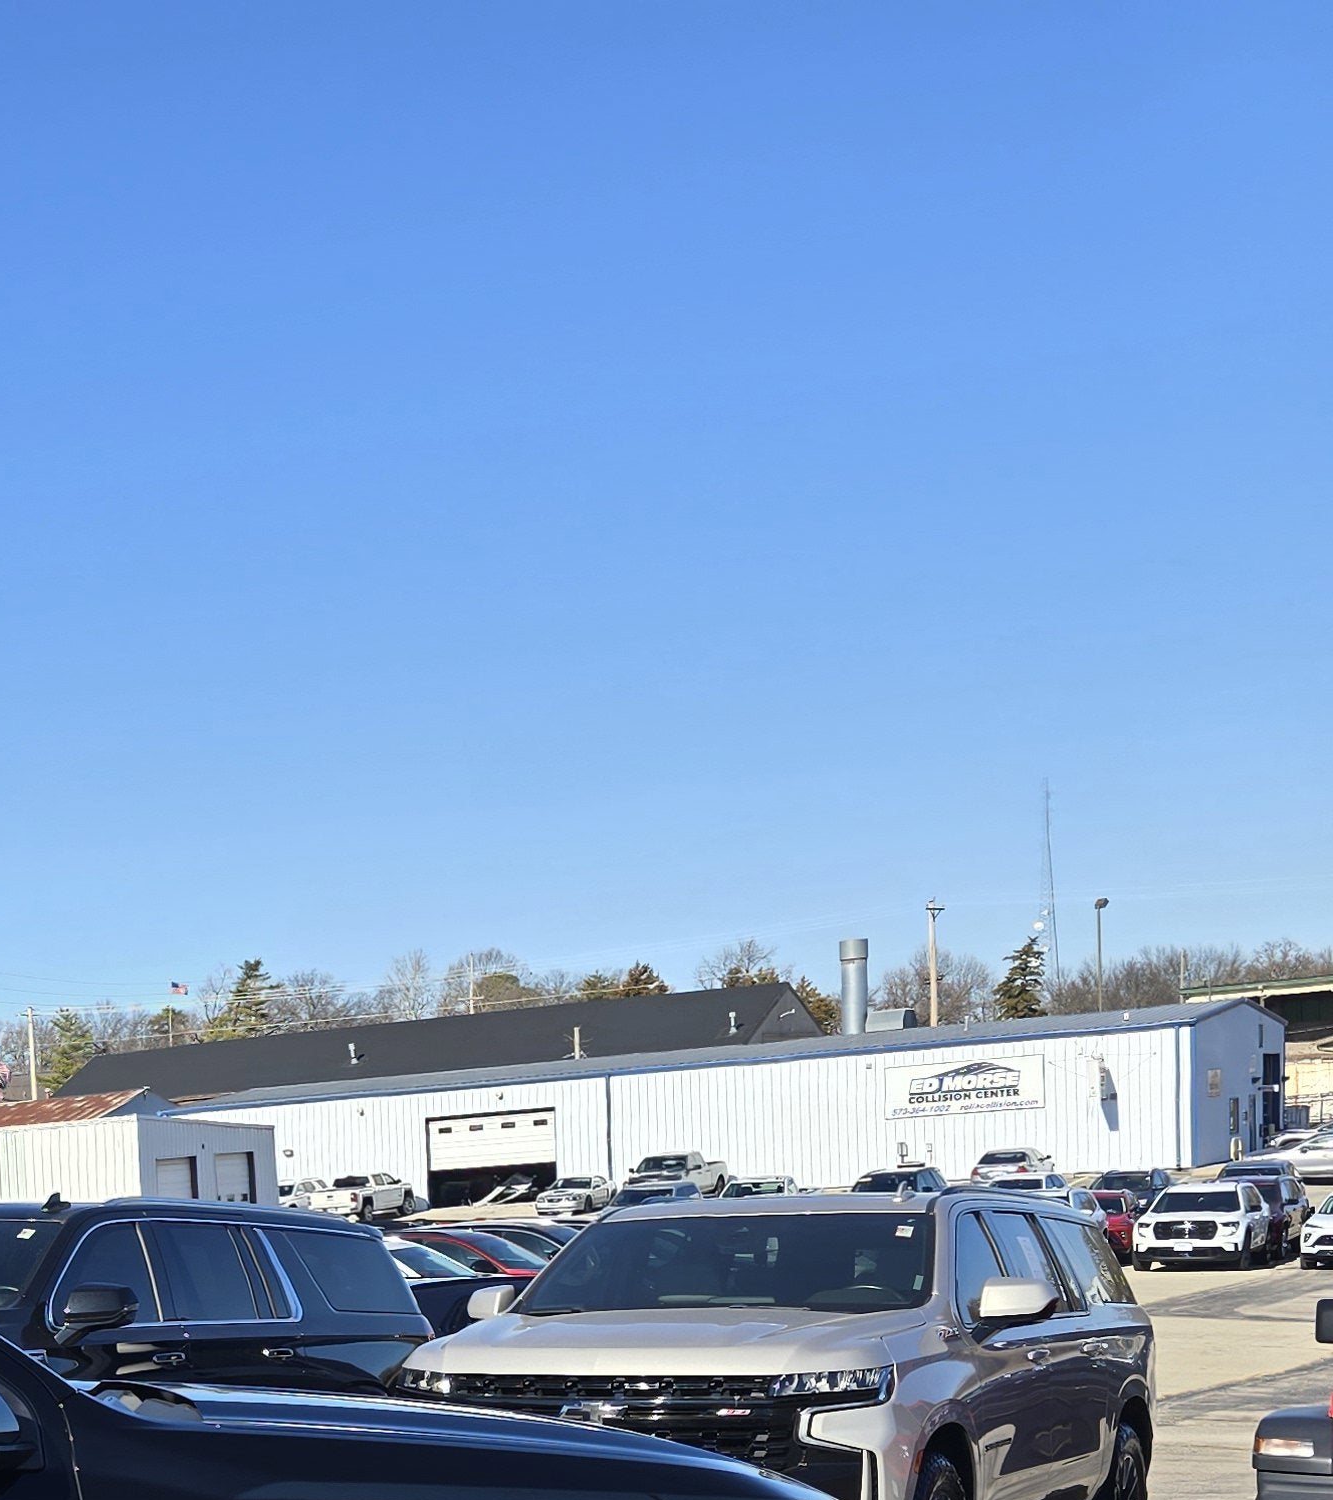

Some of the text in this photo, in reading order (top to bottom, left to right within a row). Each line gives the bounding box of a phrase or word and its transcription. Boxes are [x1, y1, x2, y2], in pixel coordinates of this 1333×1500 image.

[909, 1070, 1020, 1095] ED MORSE
[908, 1088, 1020, 1104] COLLISION CENTER
